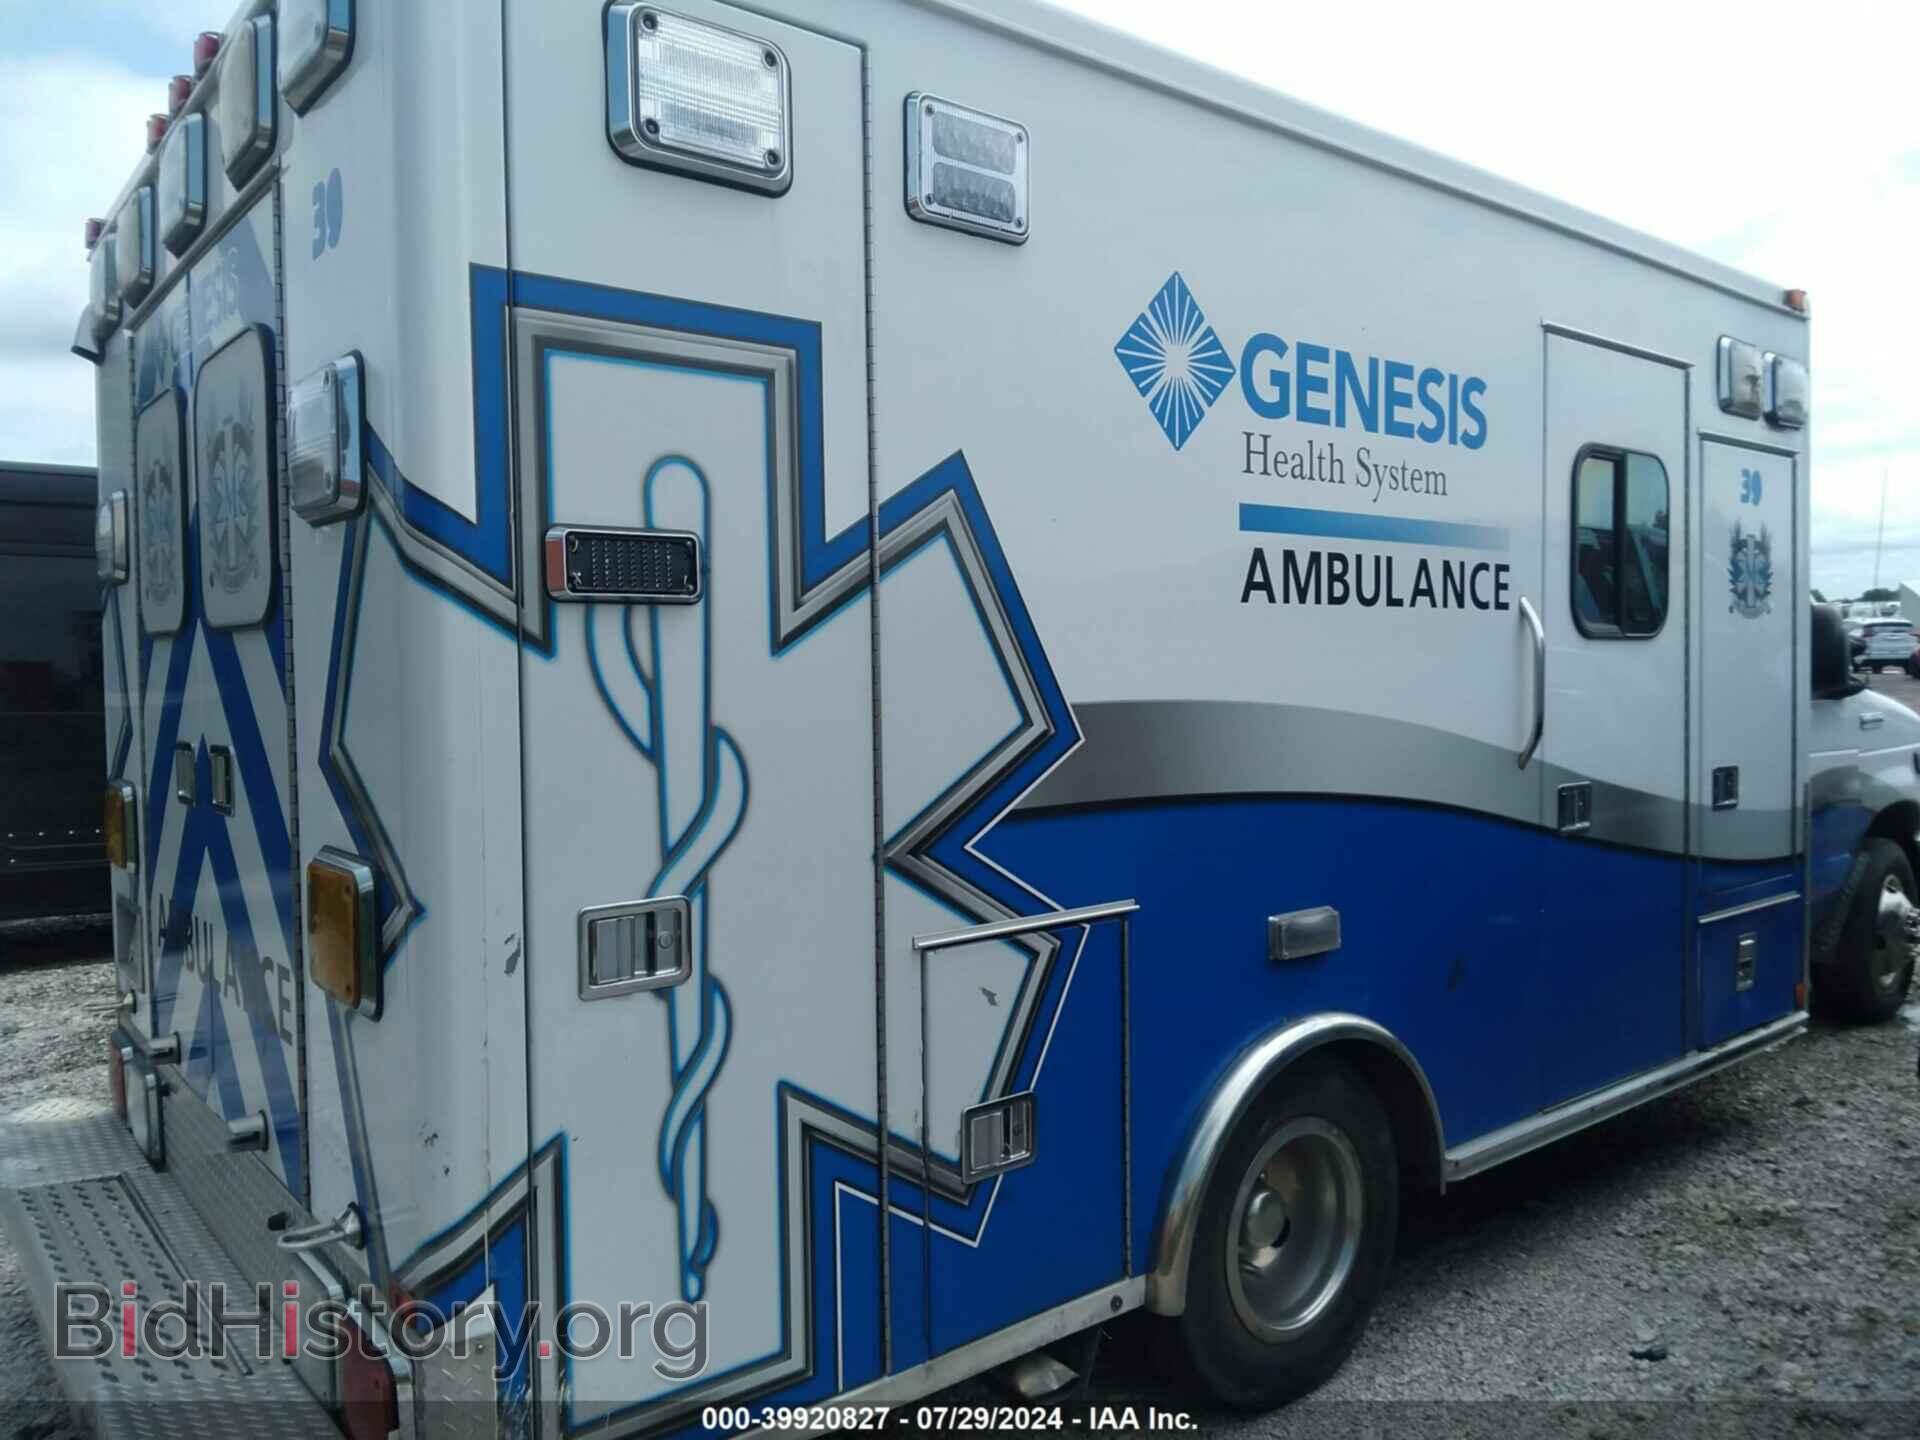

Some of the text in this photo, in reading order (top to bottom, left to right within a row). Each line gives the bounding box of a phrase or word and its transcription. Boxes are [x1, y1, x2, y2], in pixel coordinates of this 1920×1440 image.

[312, 167, 343, 261] 30
[1240, 332, 1488, 450] GENESIS
[1242, 431, 1449, 503] Health System
[1740, 468, 1762, 507] 30
[1240, 547, 1511, 611] AMBULANCE
